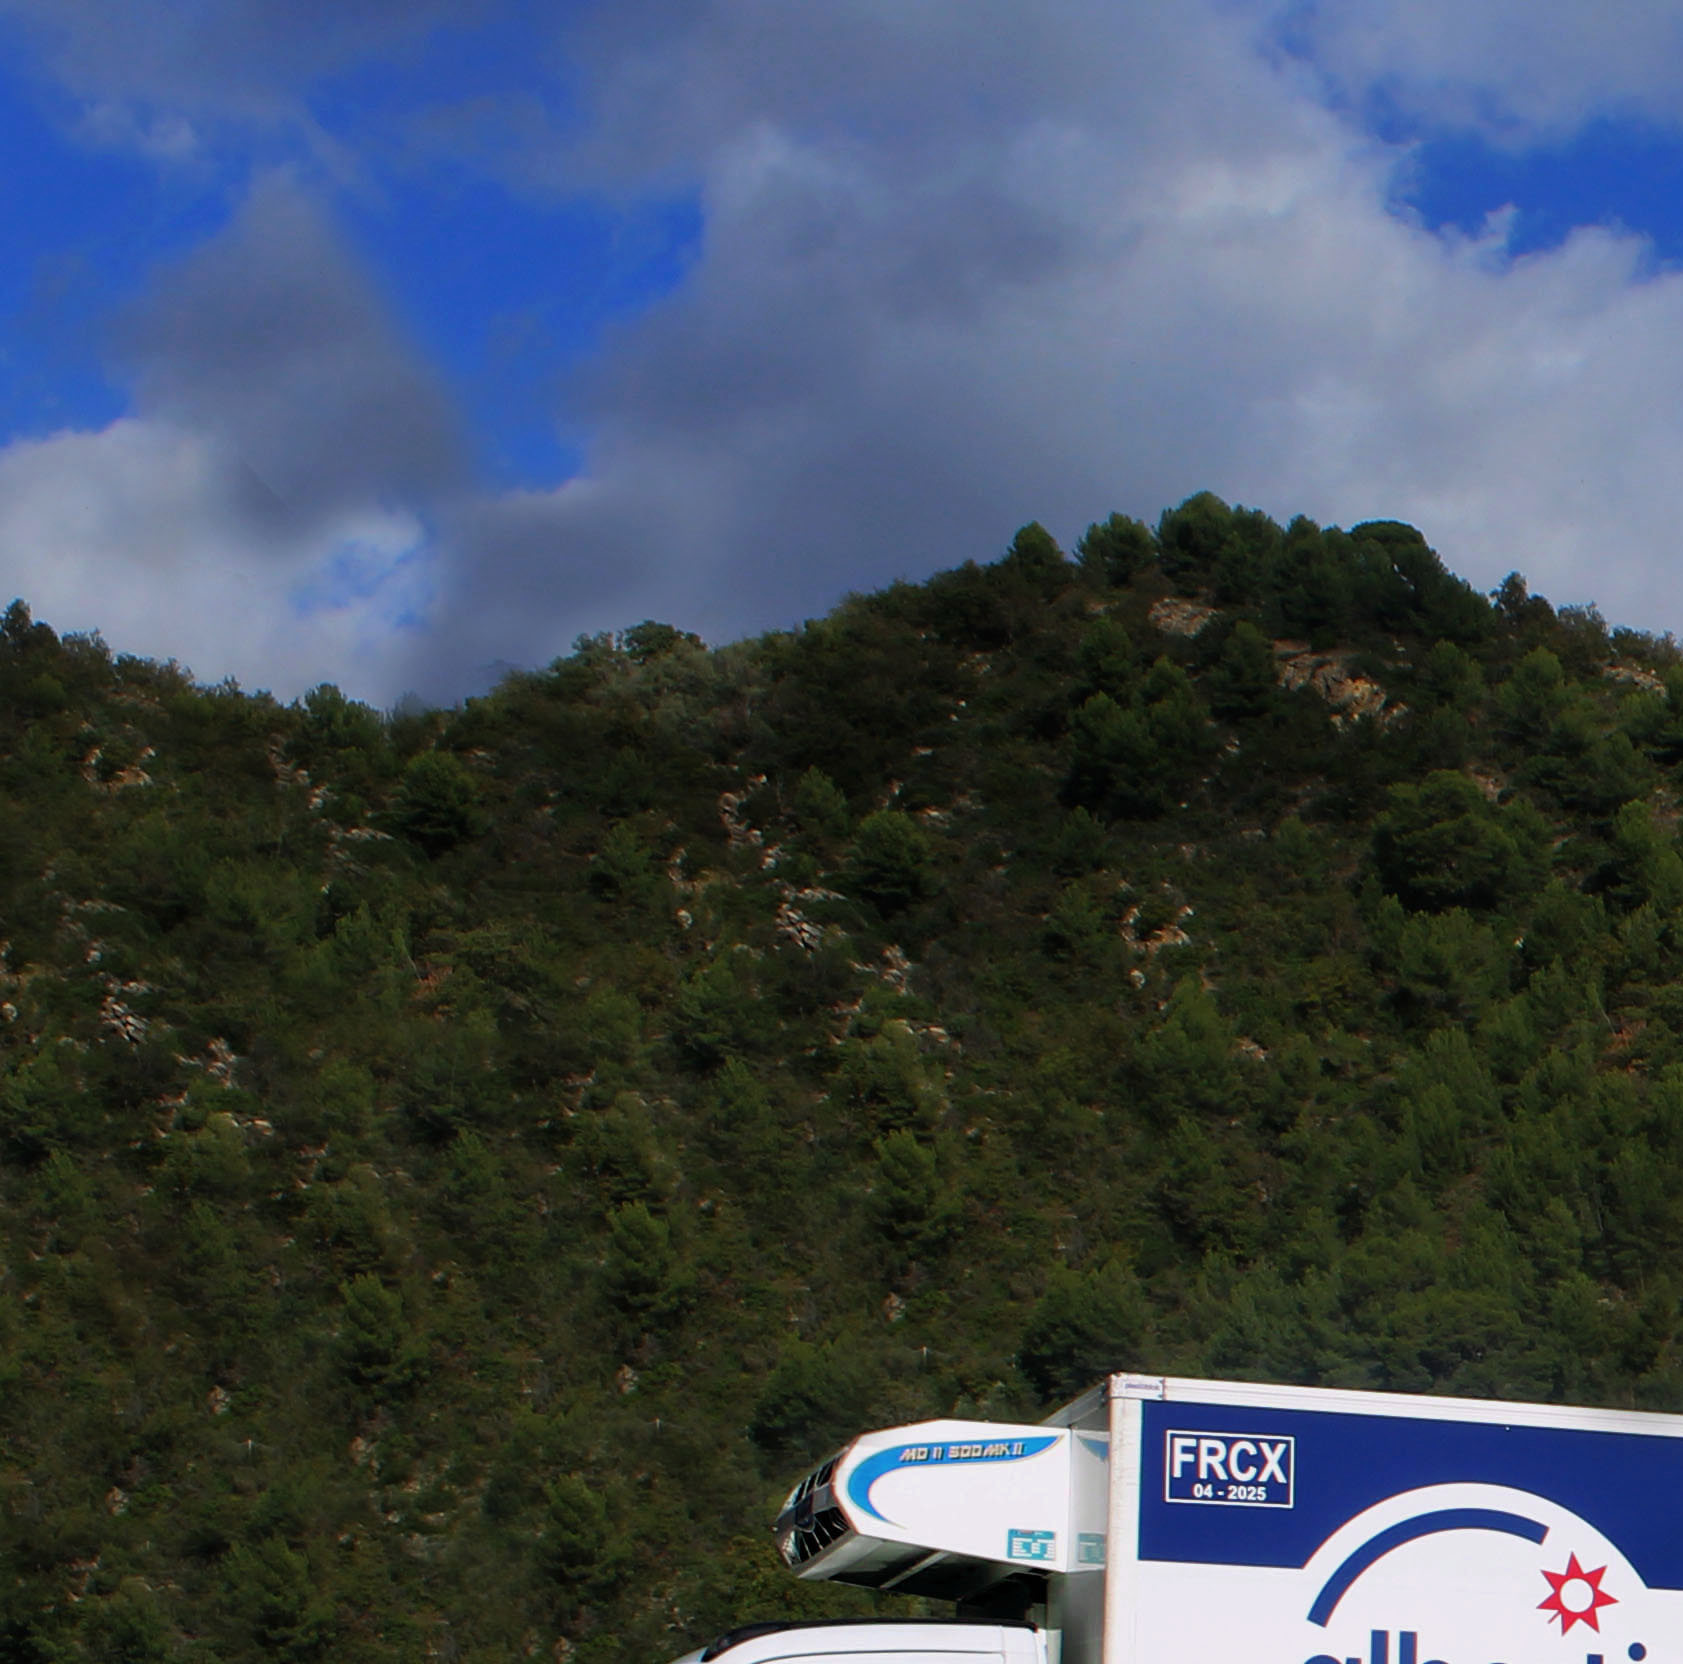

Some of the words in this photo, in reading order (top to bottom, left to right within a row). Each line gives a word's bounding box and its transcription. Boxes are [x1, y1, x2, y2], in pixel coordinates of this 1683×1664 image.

[1172, 1437, 1287, 1484] FRCX
[1192, 1483, 1212, 1499] 04
[1228, 1484, 1267, 1502] 2025
